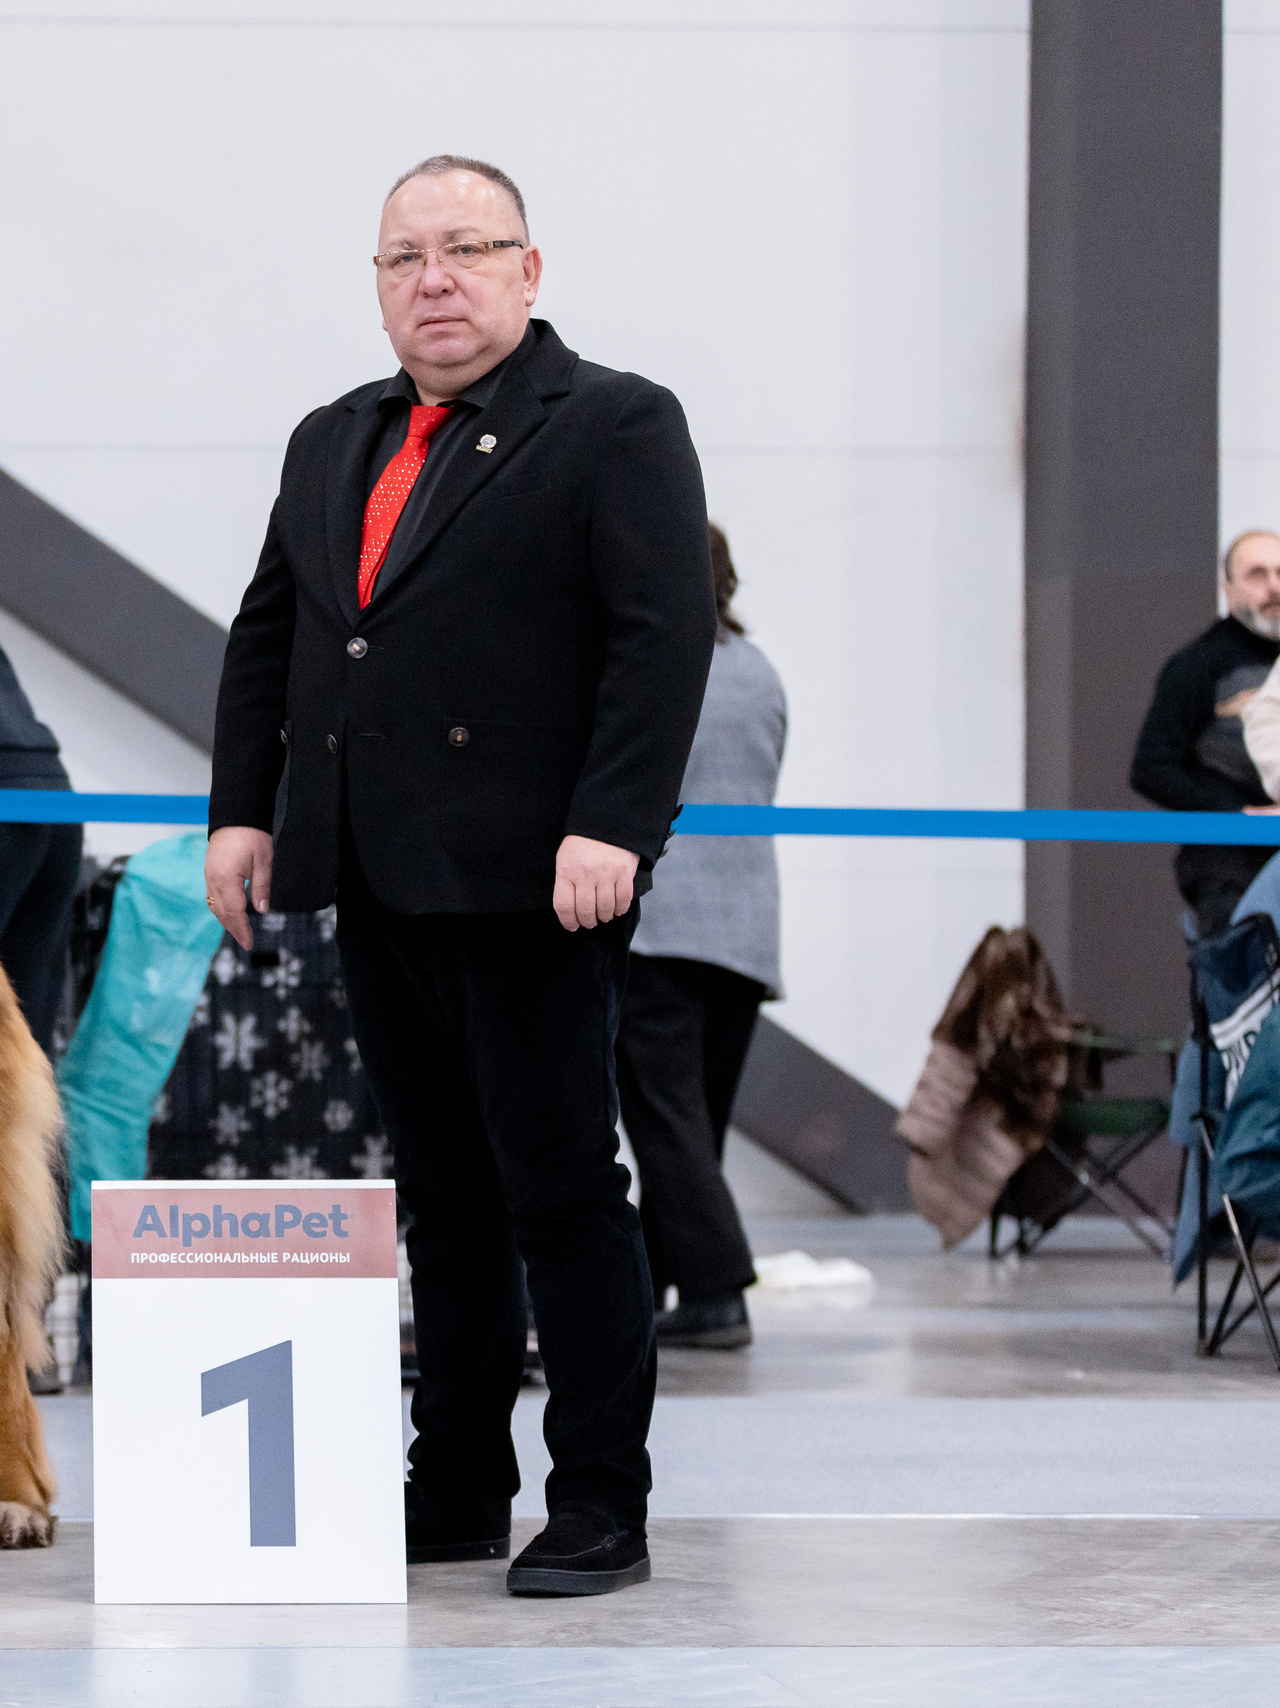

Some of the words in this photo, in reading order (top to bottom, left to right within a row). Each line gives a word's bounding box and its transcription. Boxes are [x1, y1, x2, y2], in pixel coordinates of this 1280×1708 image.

[132, 1204, 350, 1248] AlphaPet
[130, 1252, 279, 1264] ПРОФЕССИОНАЛЬНЫЕ
[282, 1252, 351, 1266] РАЦИОНЫ
[200, 1339, 297, 1548] 1
